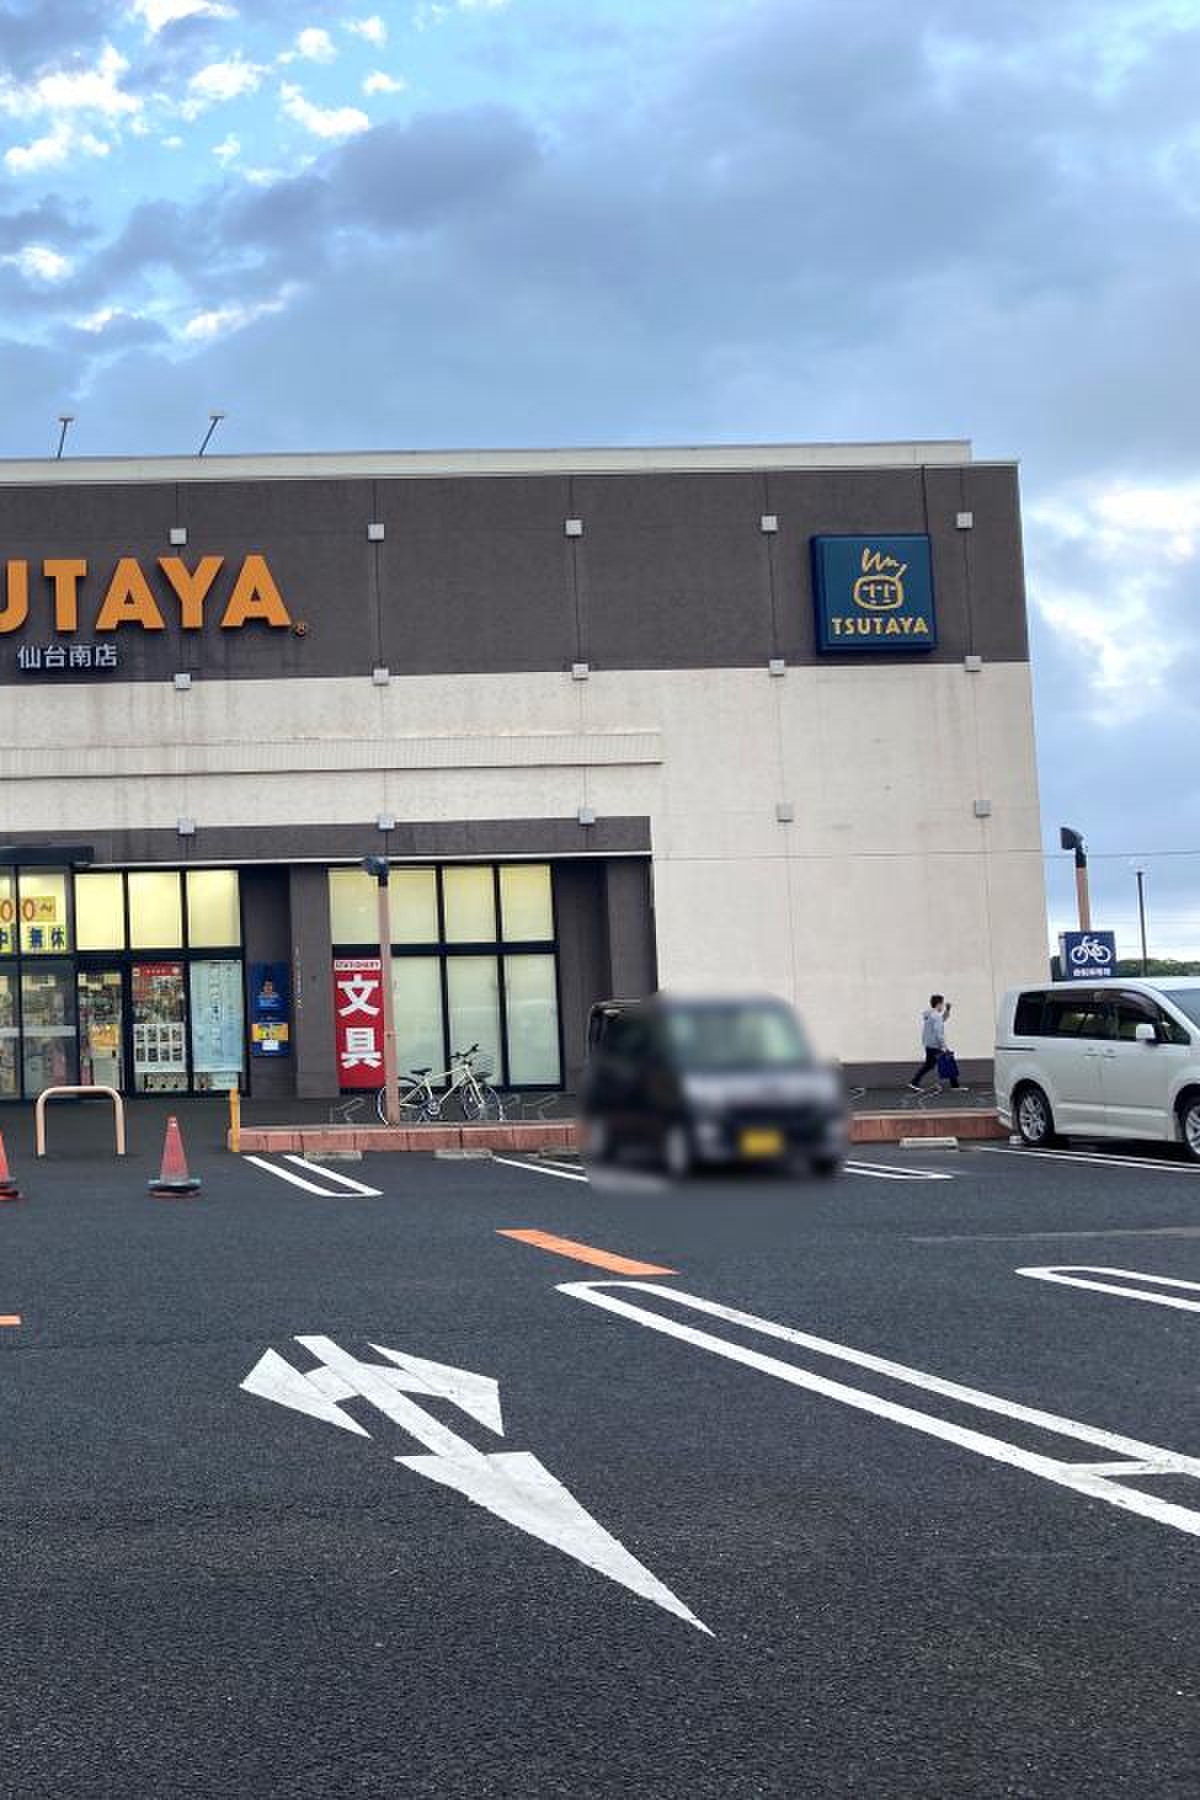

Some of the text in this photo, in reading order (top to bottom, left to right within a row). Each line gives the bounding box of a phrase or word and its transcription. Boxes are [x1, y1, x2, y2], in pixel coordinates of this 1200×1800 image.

[831, 617, 929, 635] TSUTAYA
[17, 644, 118, 669] 仙台南店
[337, 973, 382, 1069] 文具
